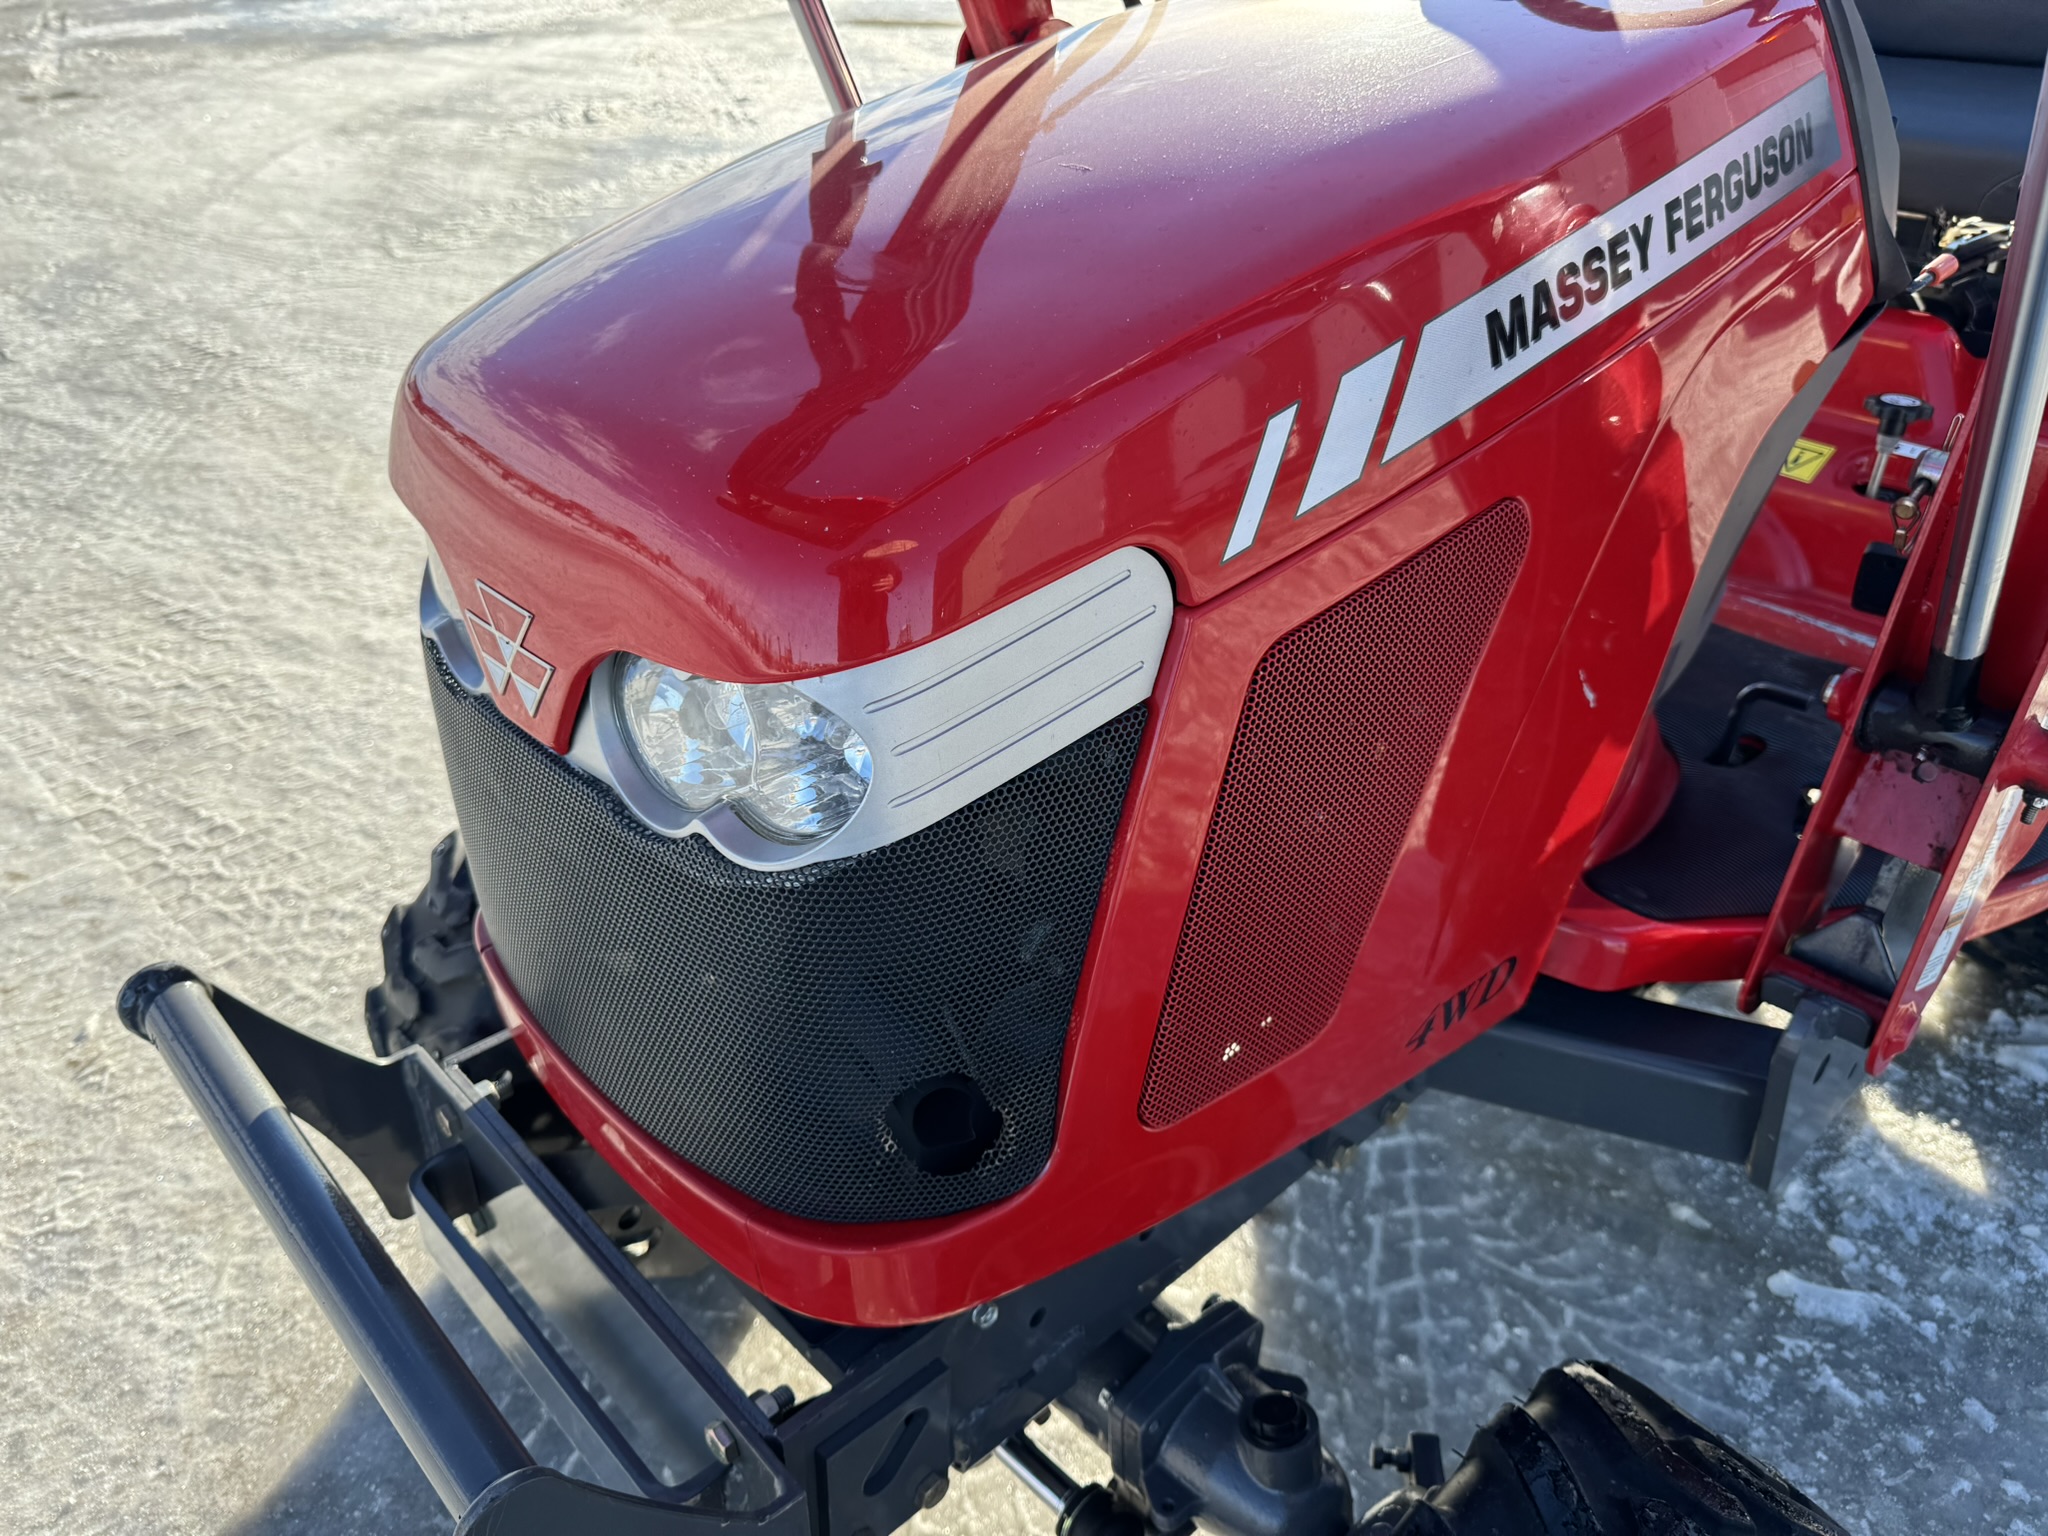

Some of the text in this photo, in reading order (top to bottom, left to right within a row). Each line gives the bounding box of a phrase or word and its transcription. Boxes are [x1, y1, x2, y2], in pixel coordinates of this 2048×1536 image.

[1485, 112, 1813, 370] MASSEY FERGUSON
[1405, 956, 1517, 1054] 4WD
